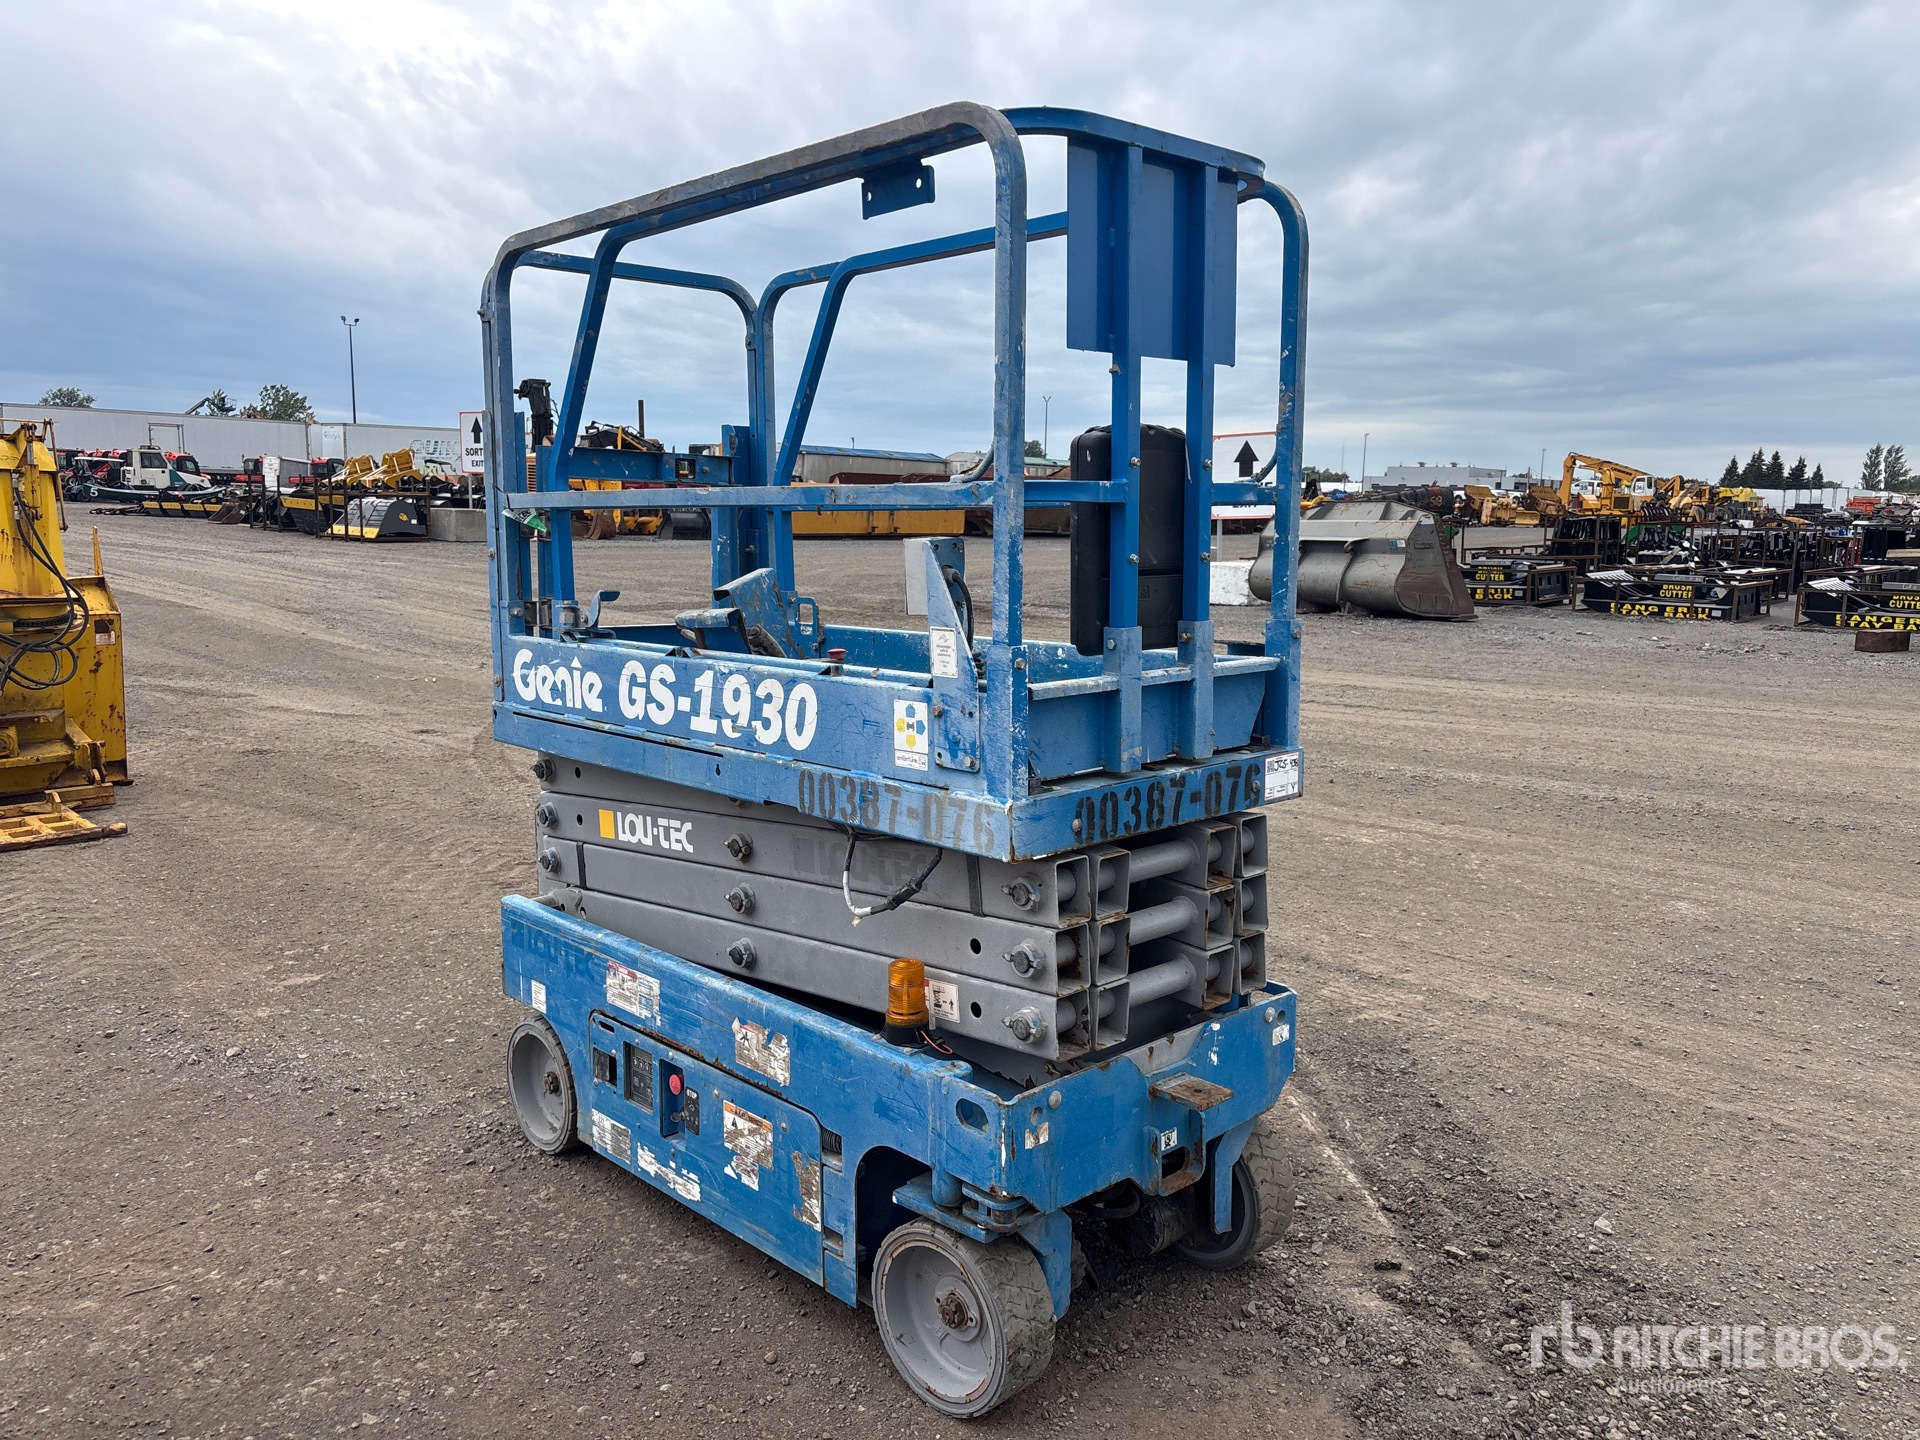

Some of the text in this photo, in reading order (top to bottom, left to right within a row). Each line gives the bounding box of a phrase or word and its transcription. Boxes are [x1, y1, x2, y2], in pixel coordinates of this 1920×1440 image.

[465, 447, 484, 457] SORT
[89, 487, 99, 498] 5
[1475, 573, 1505, 581] CUTER
[1889, 599, 1920, 609] CUTTE
[512, 648, 818, 751] Genie GS-1930
[1074, 763, 1262, 846] 00387-076
[798, 768, 996, 853] 00387-076
